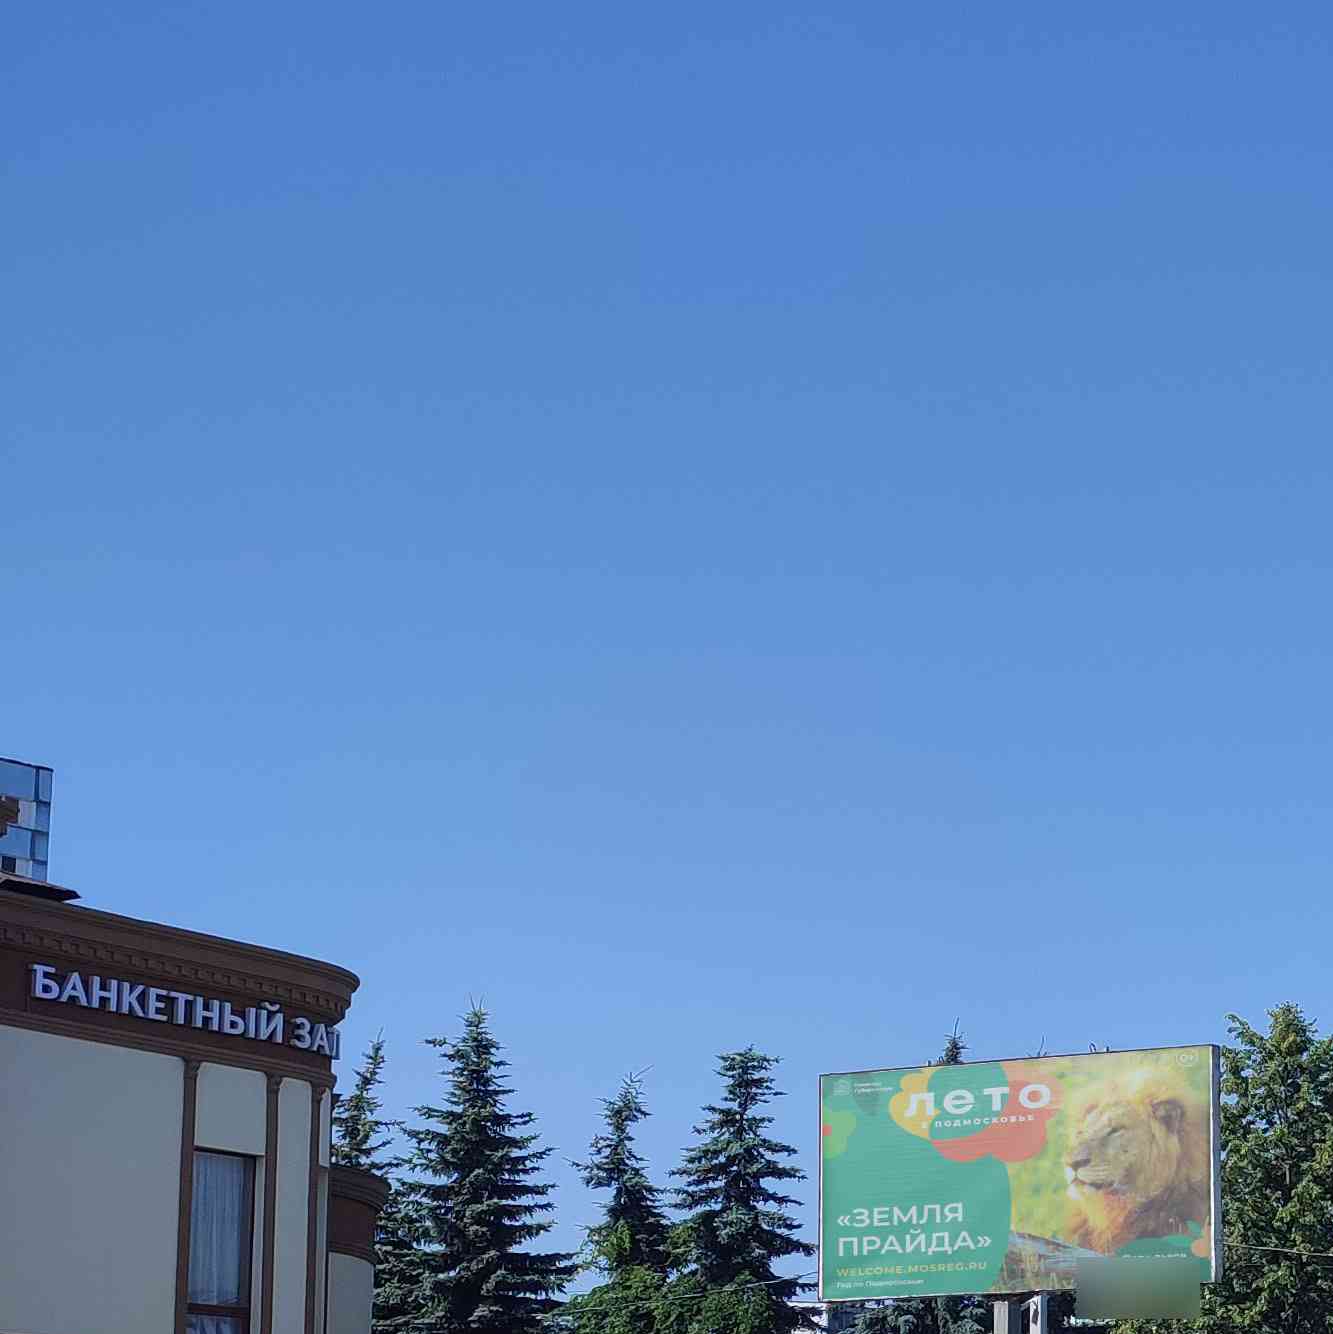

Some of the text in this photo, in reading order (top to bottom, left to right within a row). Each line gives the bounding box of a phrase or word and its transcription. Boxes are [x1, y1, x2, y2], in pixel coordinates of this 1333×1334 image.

[31, 963, 284, 1044] БАНКЕТНЫЙ
[837, 1202, 963, 1228] «ЗЕМЛЯ
[837, 1227, 992, 1257] ПРАЙДА»
